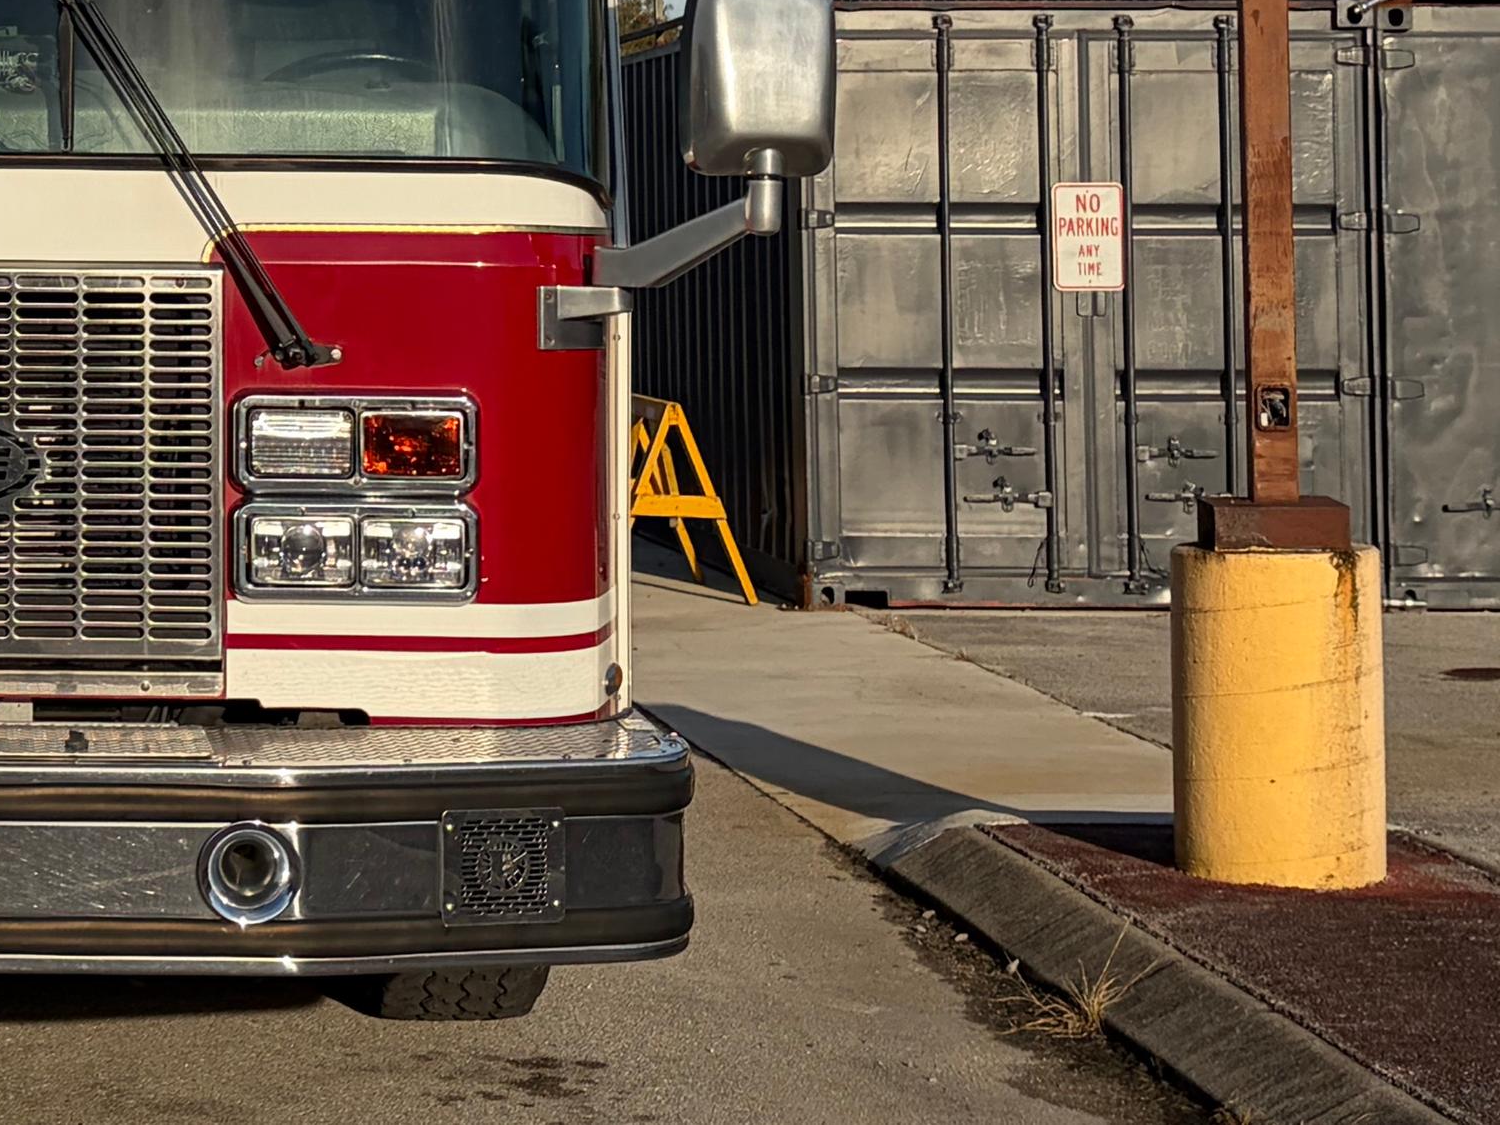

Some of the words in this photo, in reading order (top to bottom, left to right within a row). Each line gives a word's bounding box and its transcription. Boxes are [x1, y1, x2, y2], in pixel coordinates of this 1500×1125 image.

[1075, 193, 1101, 213] NO
[1058, 216, 1118, 237] PARKING
[1078, 244, 1101, 258] ANY
[1077, 262, 1102, 276] TIME
